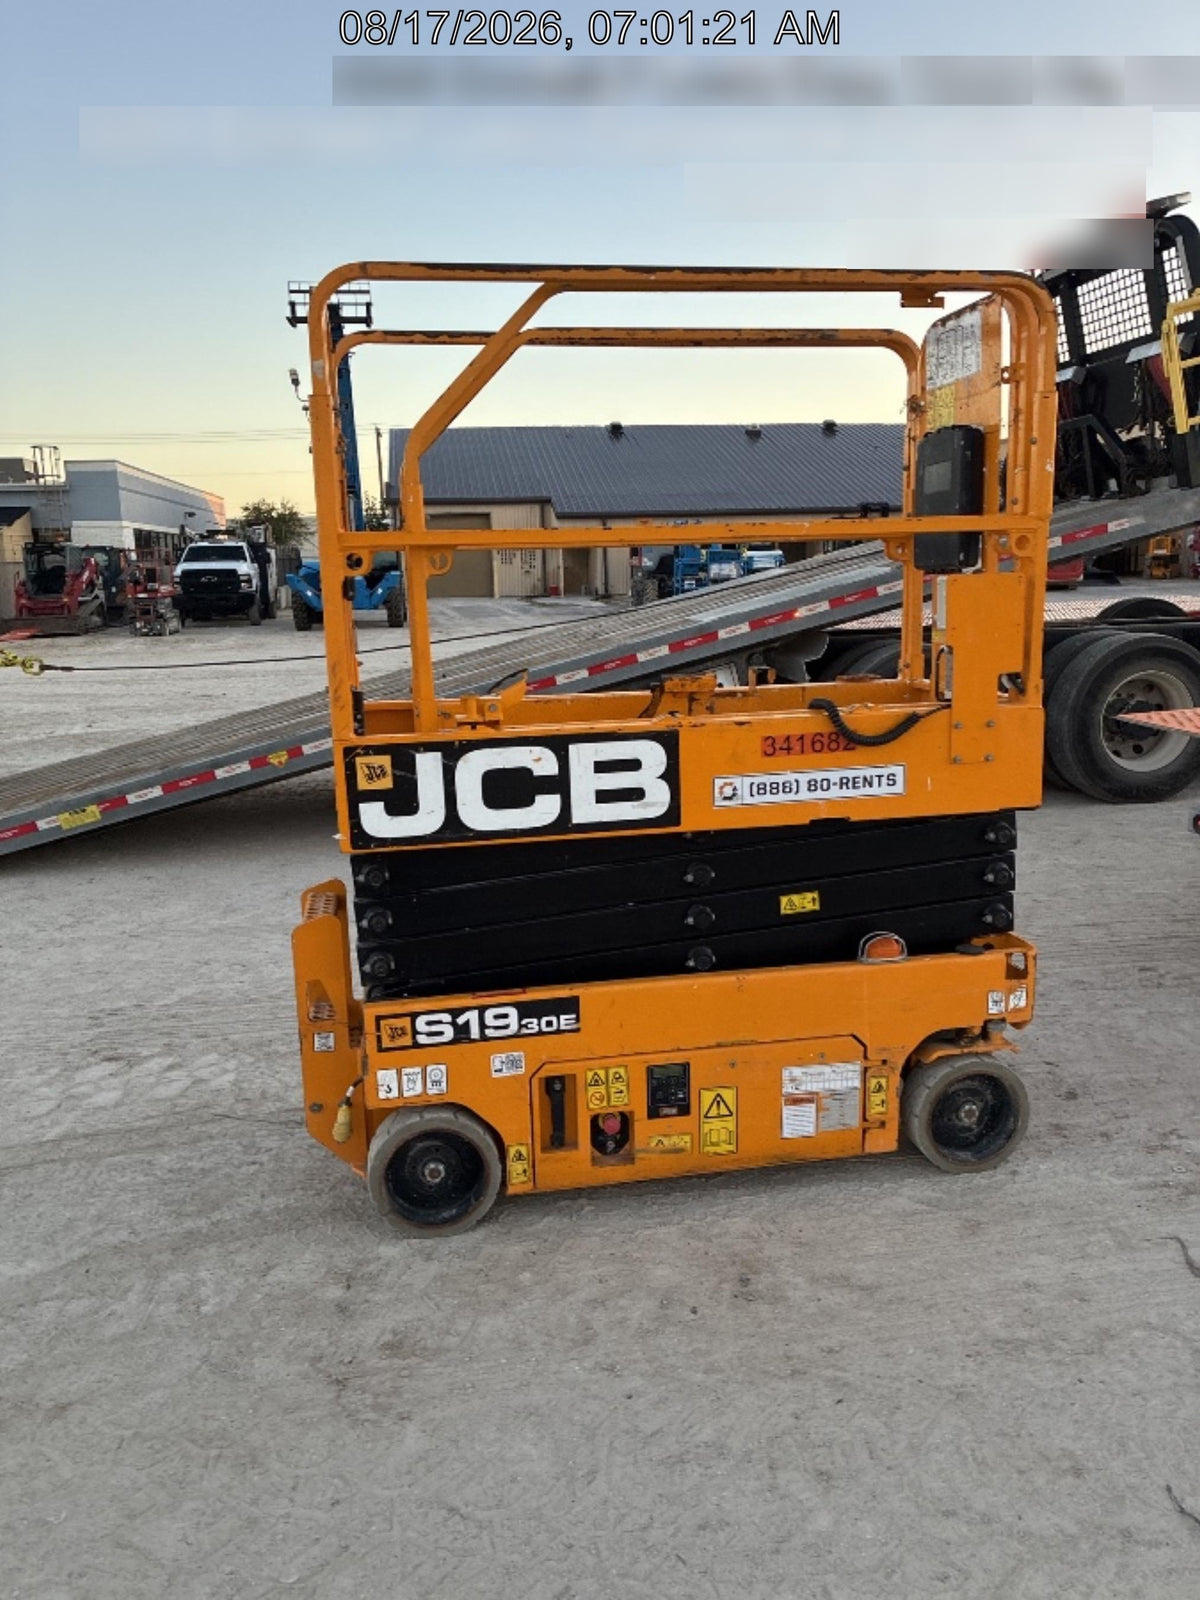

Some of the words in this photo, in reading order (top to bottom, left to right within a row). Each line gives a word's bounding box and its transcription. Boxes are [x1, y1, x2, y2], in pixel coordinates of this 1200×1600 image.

[358, 739, 671, 839] JCB
[749, 778, 800, 797] (888)
[806, 773, 897, 793] 80-RENTS
